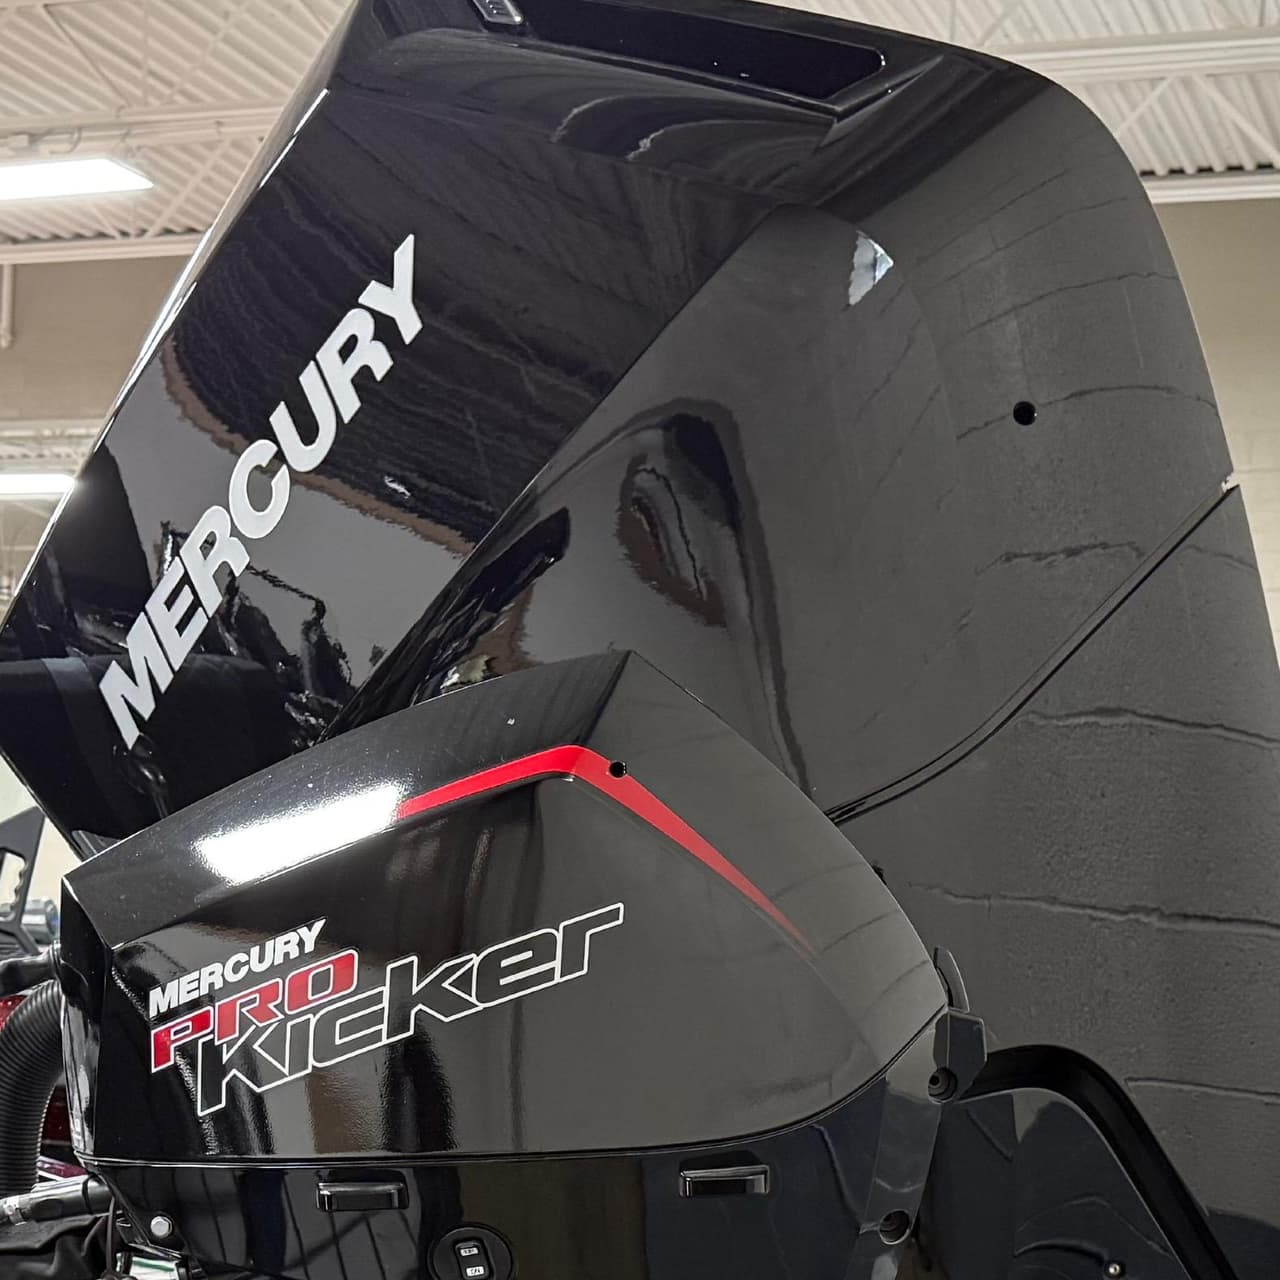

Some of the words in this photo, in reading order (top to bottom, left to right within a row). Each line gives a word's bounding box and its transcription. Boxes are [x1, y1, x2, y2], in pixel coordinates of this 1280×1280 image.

[99, 234, 423, 751] MERCURY
[149, 916, 327, 1020] MERCURY
[150, 948, 359, 1074] PRO
